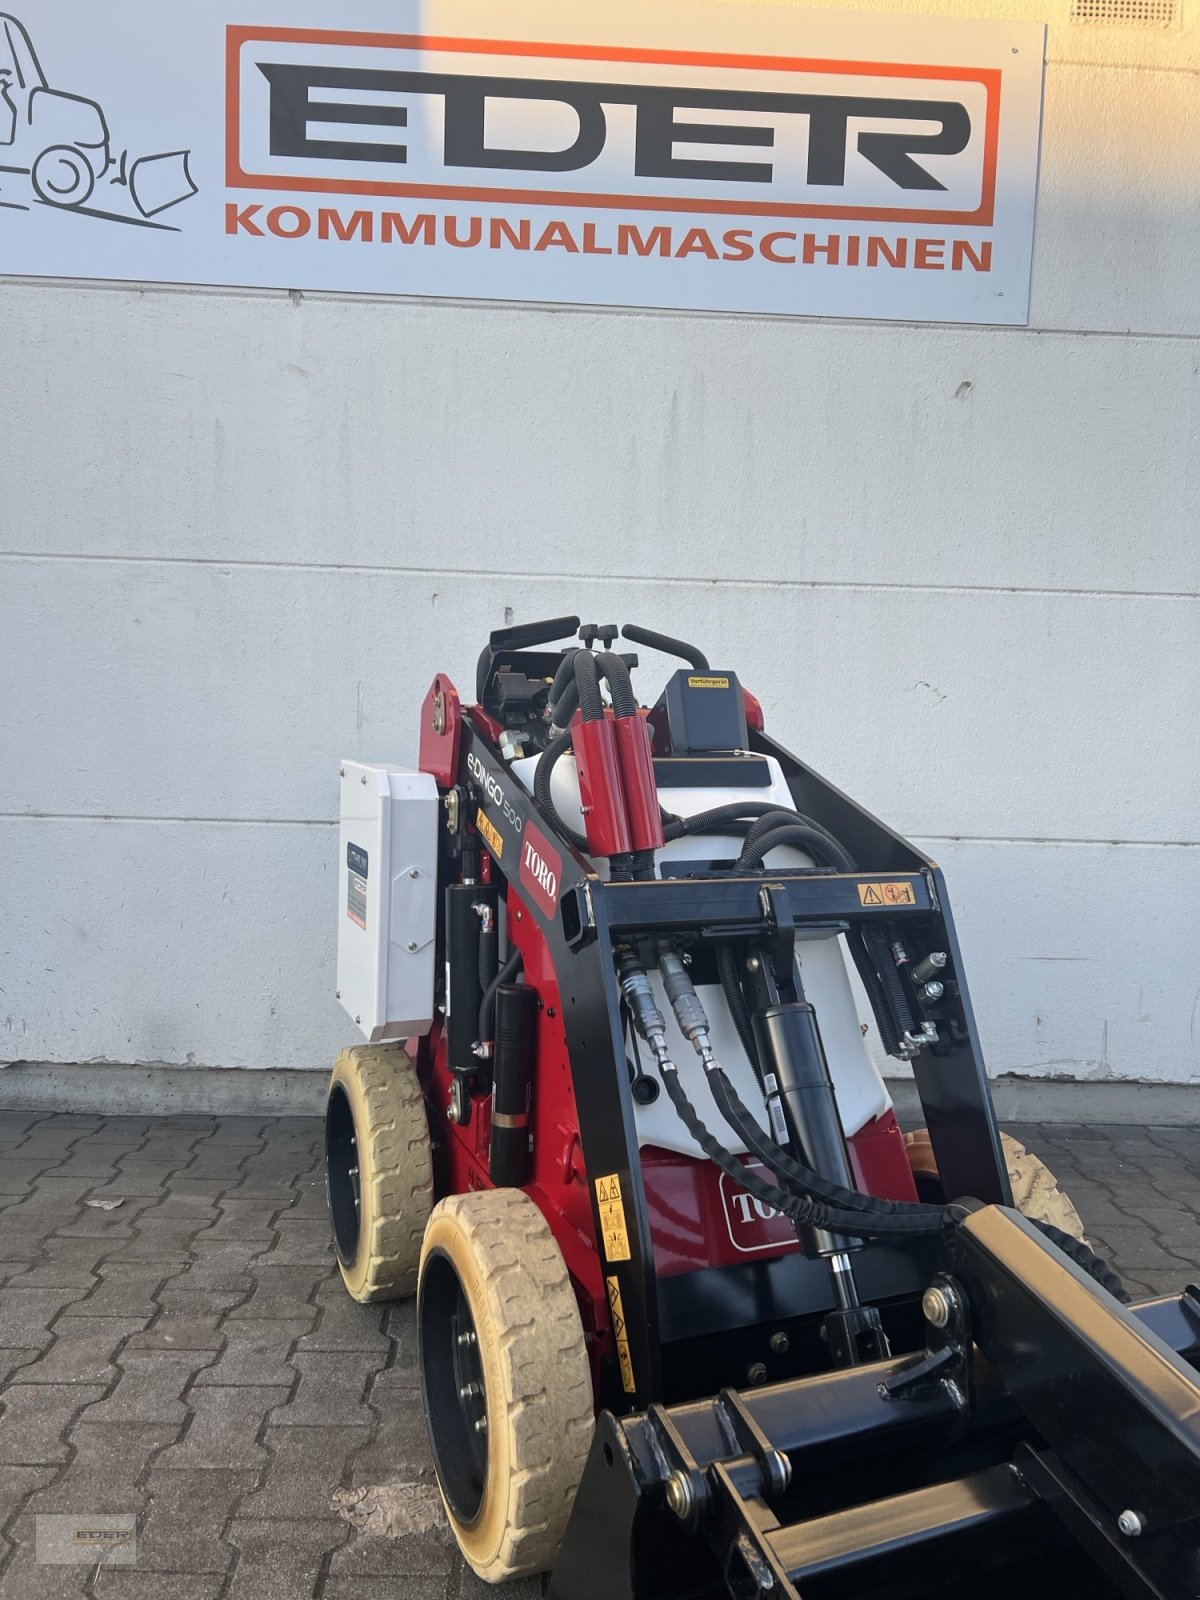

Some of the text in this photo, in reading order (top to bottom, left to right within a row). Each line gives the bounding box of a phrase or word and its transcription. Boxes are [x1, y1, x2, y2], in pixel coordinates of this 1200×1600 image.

[255, 62, 972, 191] EDER
[225, 203, 993, 272] KOMMUNALMASCHINEN
[502, 801, 522, 833] 500
[525, 841, 556, 898] TORO
[732, 1193, 785, 1223] TO
